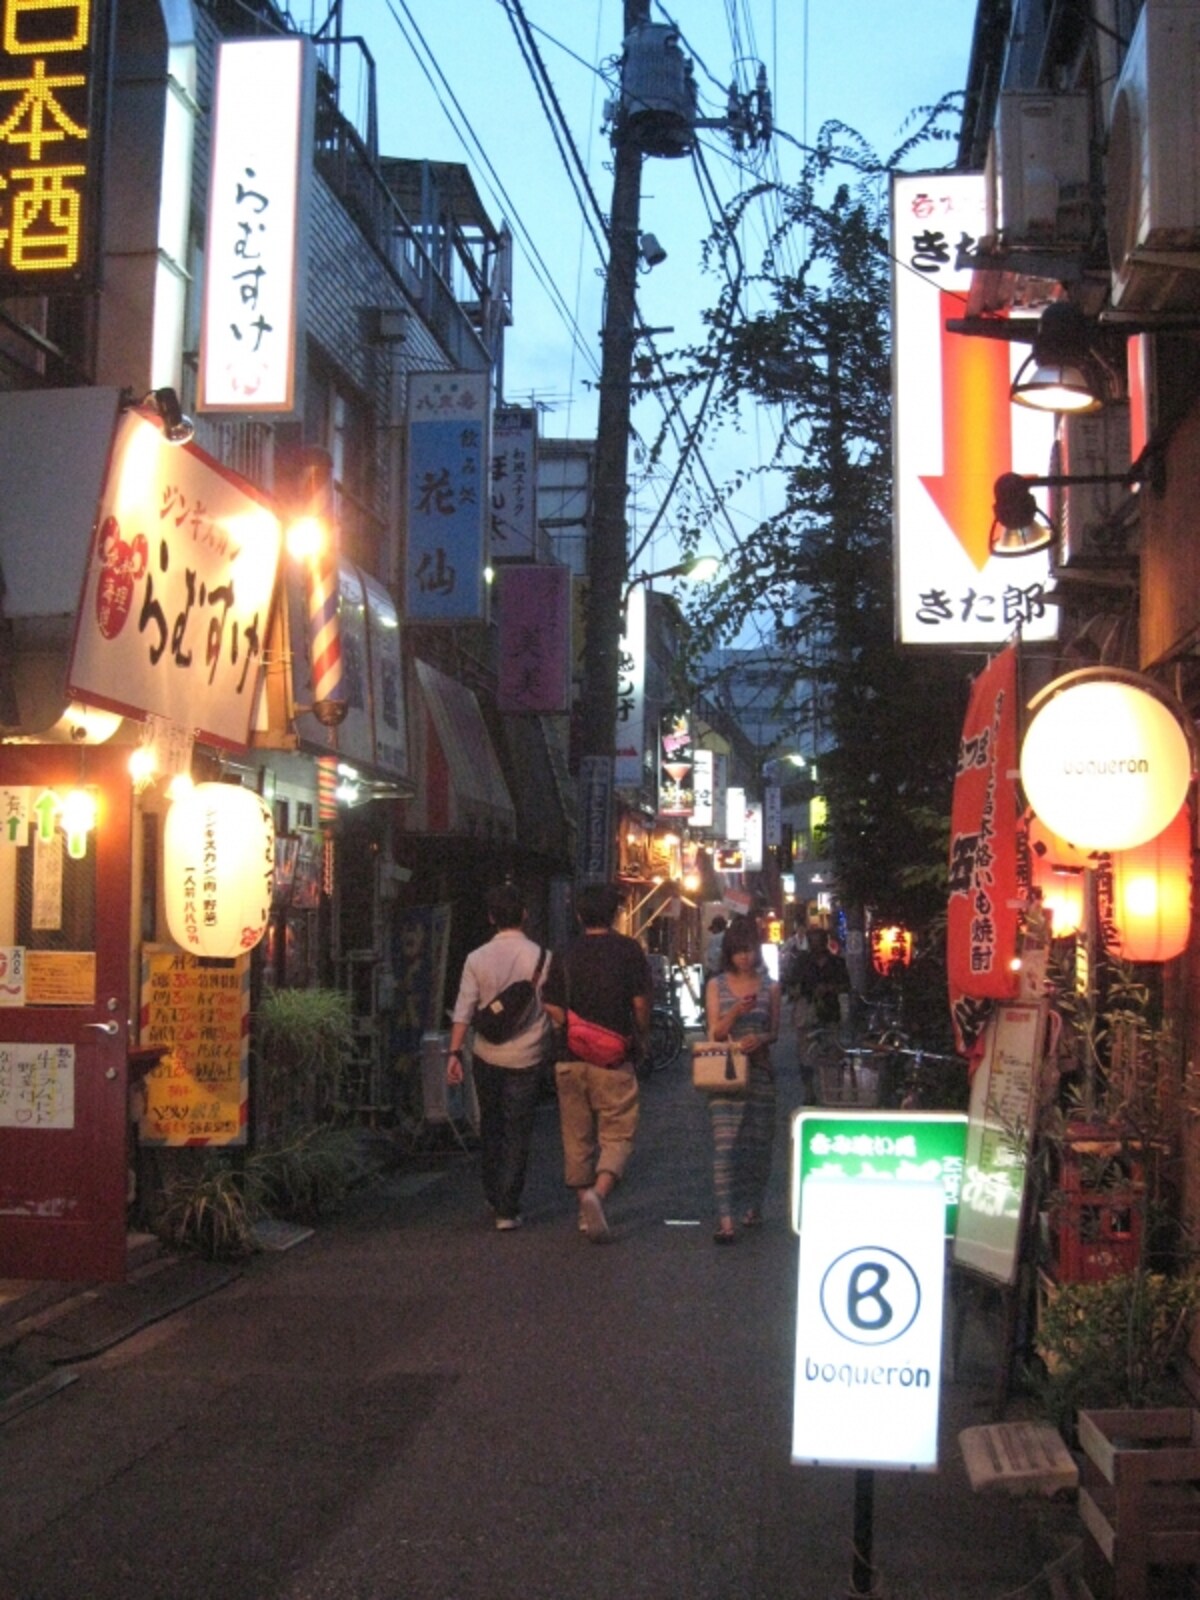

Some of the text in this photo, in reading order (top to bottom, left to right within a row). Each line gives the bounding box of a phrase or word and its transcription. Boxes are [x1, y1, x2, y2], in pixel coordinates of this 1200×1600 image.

[231, 168, 273, 353] らむすけ
[414, 467, 457, 597] 花仙
[915, 583, 1045, 625] きた郎
[805, 1357, 931, 1389] boquerón
